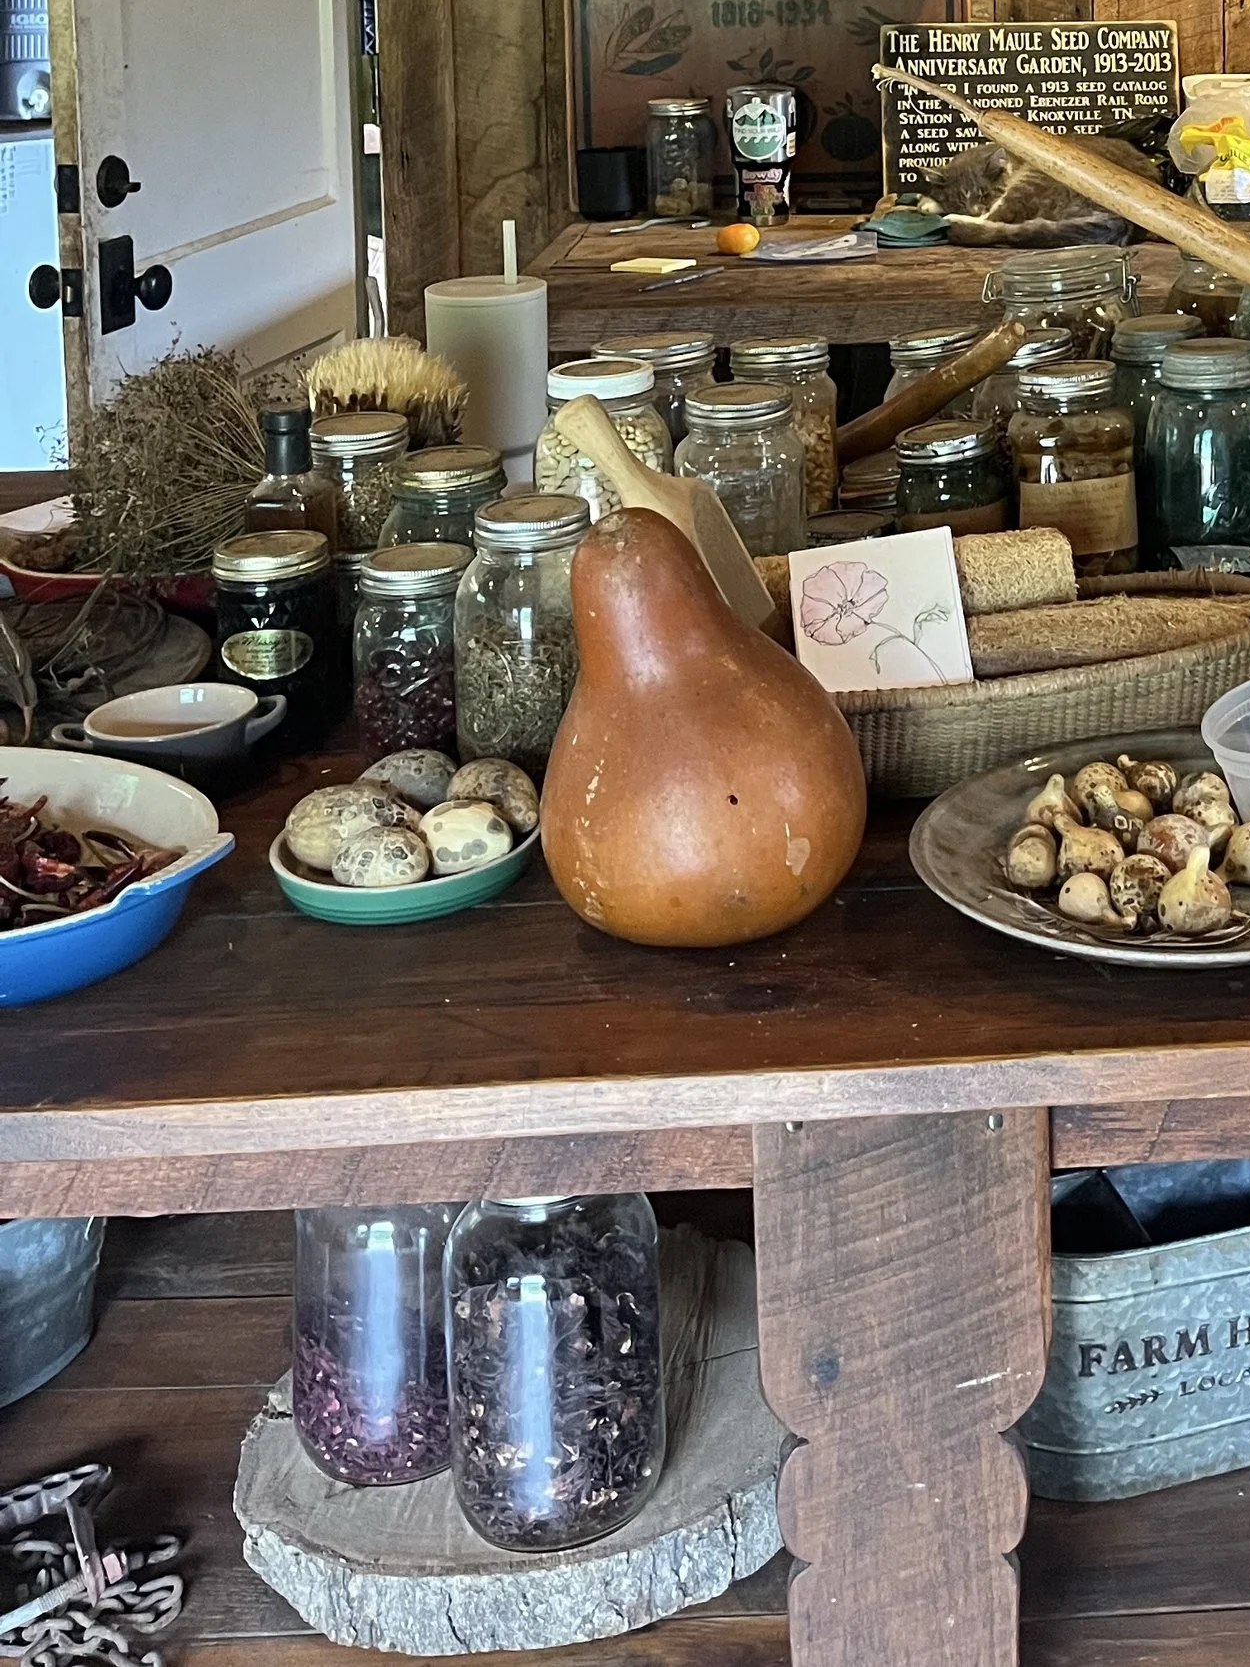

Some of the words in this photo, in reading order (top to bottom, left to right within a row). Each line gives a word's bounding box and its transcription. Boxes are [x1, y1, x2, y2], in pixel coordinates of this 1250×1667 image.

[887, 30, 920, 53] THE
[928, 29, 981, 53] HENRY
[989, 28, 1043, 52] MAULE
[1051, 27, 1090, 51] SEED
[1097, 27, 1170, 49] COMPANY
[895, 56, 1008, 77] ANNIVERSARY
[1016, 54, 1087, 77] GARDEN,
[1094, 52, 1172, 73] 1913-2013
[963, 82, 970, 94] I
[976, 83, 1019, 94] FOUND
[1025, 83, 1035, 94] A
[1041, 81, 1069, 93] 1913
[1075, 81, 1106, 92] SEED
[1113, 80, 1168, 91] CATALOG
[897, 99, 911, 111] IN
[918, 99, 942, 110] THE
[1030, 95, 1090, 107] EBENEZER
[1097, 94, 1128, 106] RAIL
[1134, 93, 1168, 105] ROAD
[899, 112, 953, 125] STATION
[1027, 109, 1102, 121] KNOXVILLE
[900, 129, 910, 139] A
[917, 128, 949, 138] SEED
[900, 142, 940, 153] ALONG
[898, 172, 917, 183] TO
[1078, 1323, 1213, 1377] FARM
